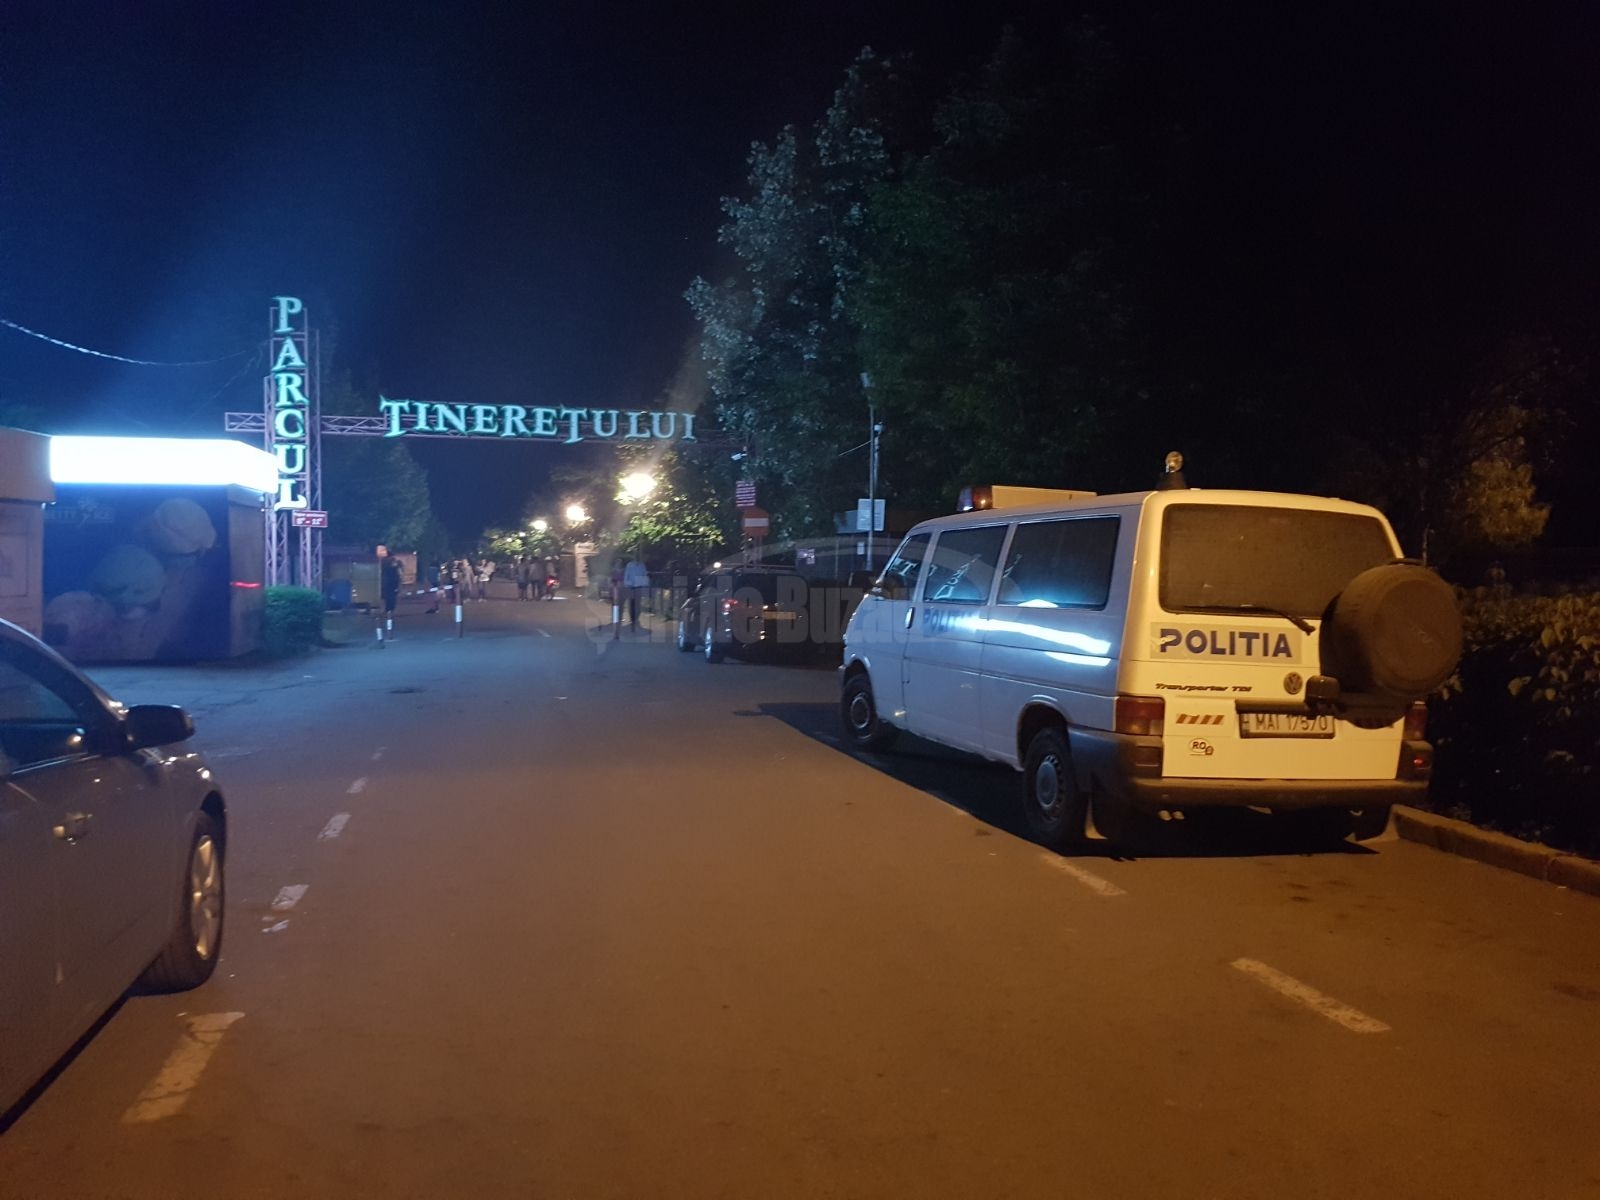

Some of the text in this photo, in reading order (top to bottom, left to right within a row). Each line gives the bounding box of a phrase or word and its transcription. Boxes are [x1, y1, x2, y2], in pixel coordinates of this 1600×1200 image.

[272, 295, 309, 511] PARCUL
[379, 394, 697, 444] TINERETULUI
[1160, 628, 1293, 658] POLITIA
[1155, 682, 1229, 692] Transporter
[1255, 713, 1280, 730] MAI
[1192, 741, 1207, 750] RO
